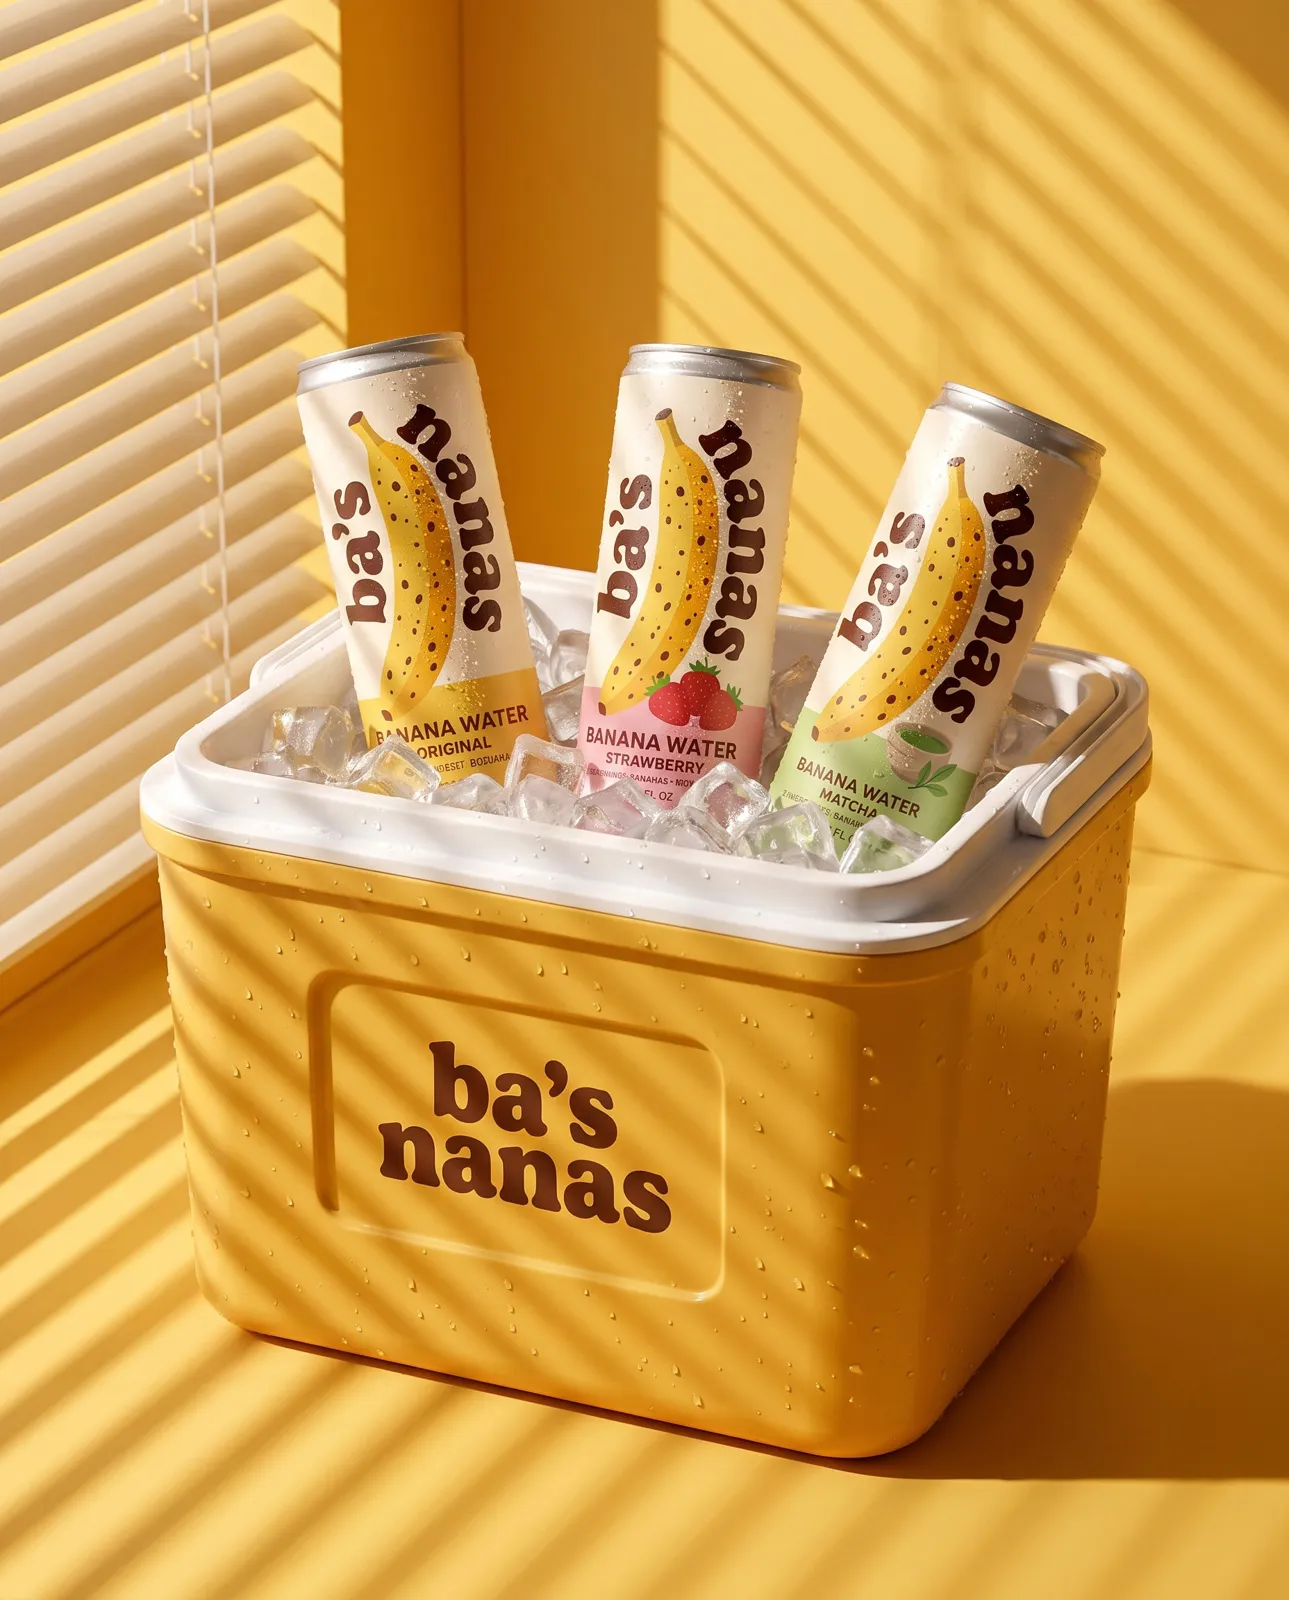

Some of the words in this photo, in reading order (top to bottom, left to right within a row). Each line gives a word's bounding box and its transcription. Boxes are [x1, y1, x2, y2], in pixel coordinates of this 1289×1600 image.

[332, 481, 387, 626] ba's
[397, 403, 502, 633] nanas
[597, 474, 653, 619] ba's
[698, 419, 766, 661] nanas
[836, 511, 926, 652] ba's
[932, 484, 1035, 724] nanas
[417, 735, 492, 760] ORIGINAL
[459, 704, 529, 734] WATER
[586, 726, 661, 752] BANANA
[666, 735, 737, 760] WATER
[605, 751, 705, 775] STRAWBERRY
[658, 791, 674, 802] OZ
[796, 756, 857, 794] BANANA
[863, 783, 921, 819] WATER
[819, 787, 878, 818] MATCHA
[832, 827, 846, 841] FL
[428, 1040, 618, 1149] ba's
[378, 1121, 672, 1234] nanas
